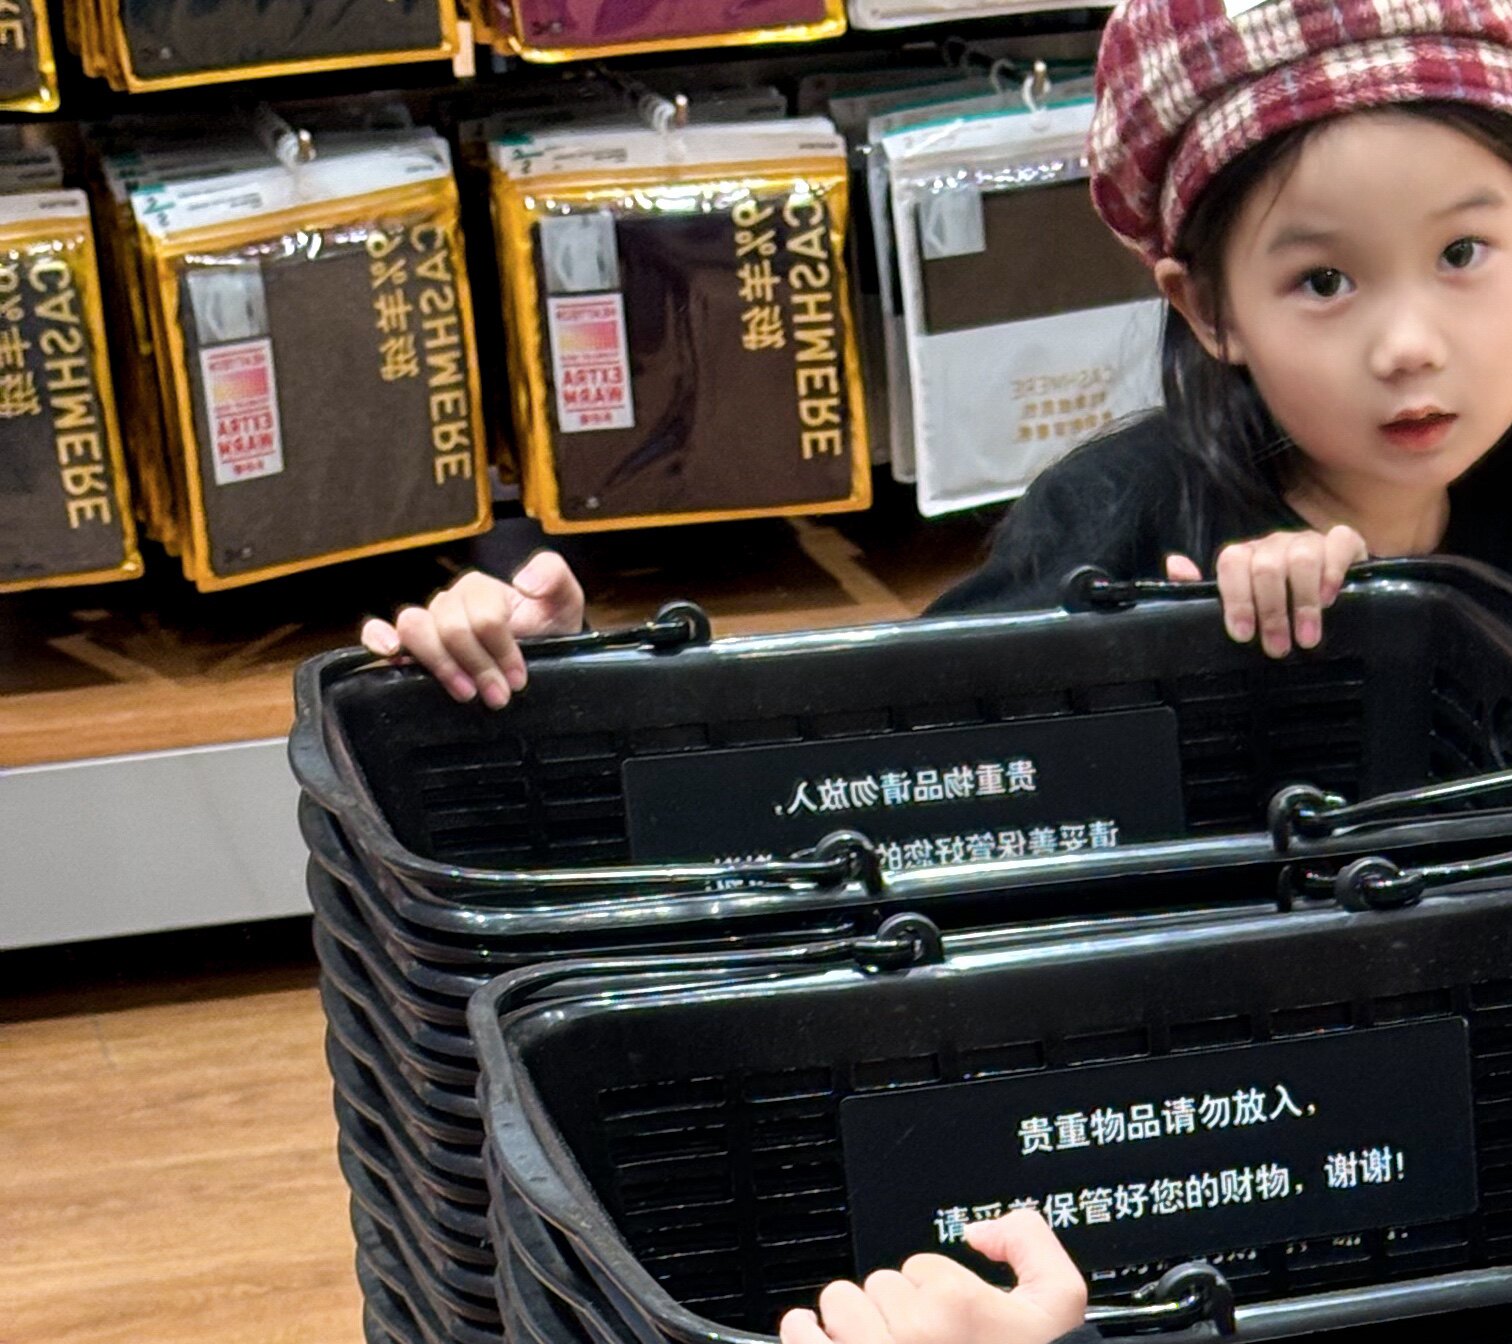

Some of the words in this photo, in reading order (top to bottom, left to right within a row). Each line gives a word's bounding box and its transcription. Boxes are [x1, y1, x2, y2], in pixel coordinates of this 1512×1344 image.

[1018, 1084, 1318, 1156] 贵重物品请勿放入，
